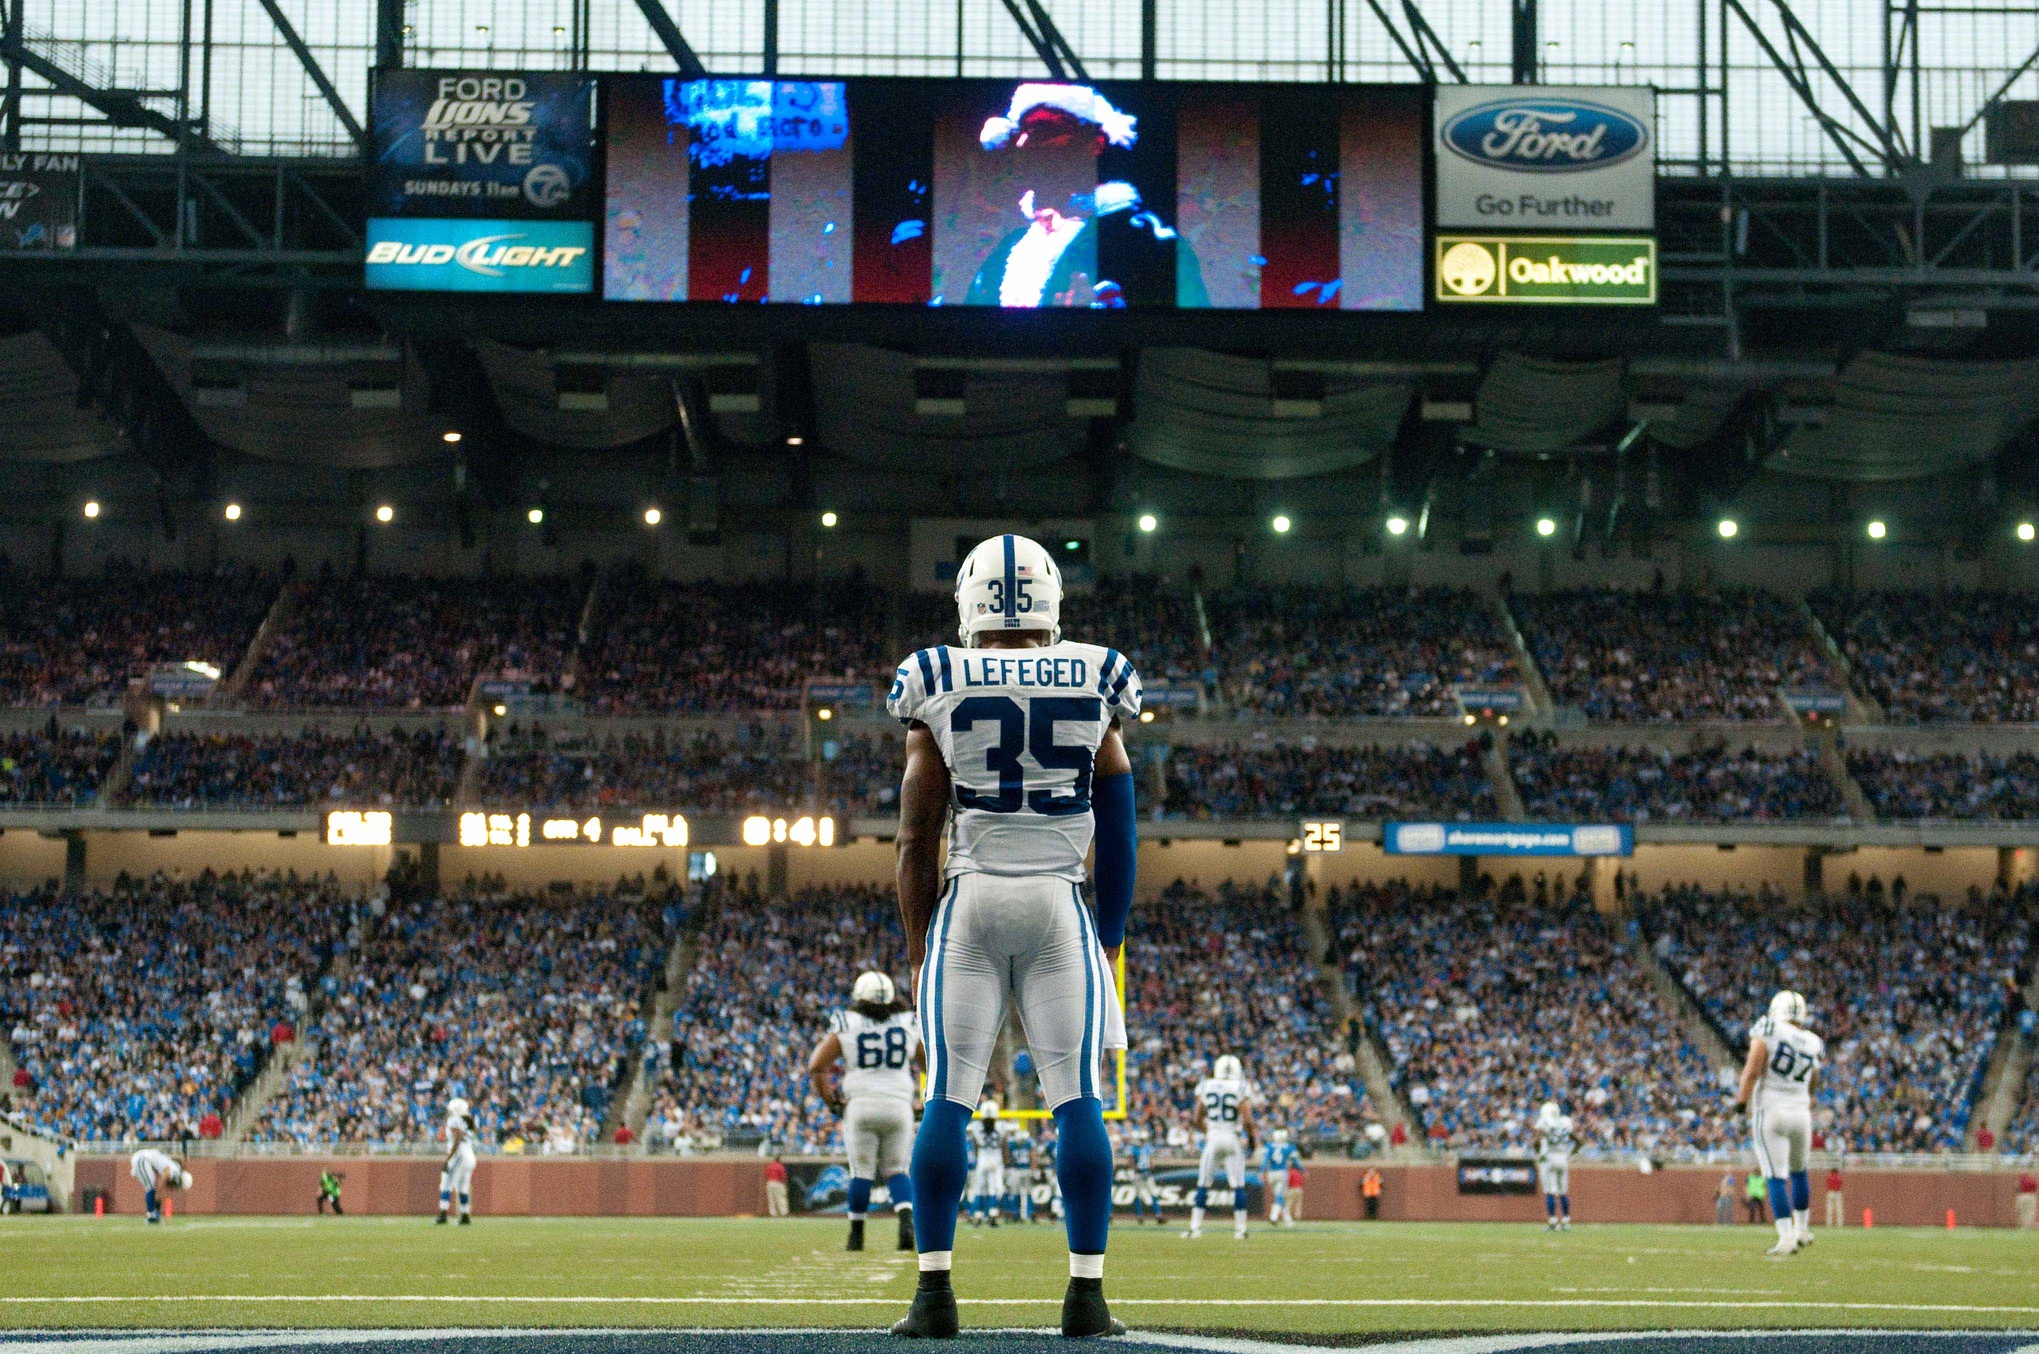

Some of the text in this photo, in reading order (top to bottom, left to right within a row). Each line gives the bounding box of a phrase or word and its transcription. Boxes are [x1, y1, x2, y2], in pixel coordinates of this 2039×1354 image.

[438, 78, 527, 100] FORD
[422, 99, 537, 129] LIONS
[425, 129, 538, 142] REPORT
[1481, 108, 1607, 160] Ford
[33, 154, 79, 172] FAN
[425, 142, 533, 165] LIVE
[404, 180, 481, 196] SUNDAYS
[1475, 194, 1615, 217] Go Further
[366, 241, 587, 267] BUD LIGHT
[1508, 255, 1650, 285] Oakwood
[988, 579, 1033, 614] 35
[962, 657, 1087, 688] LEFEGED
[950, 696, 1102, 816] 35
[1303, 822, 1341, 852] 25
[857, 1026, 907, 1070] 68
[1206, 1092, 1239, 1122] 26
